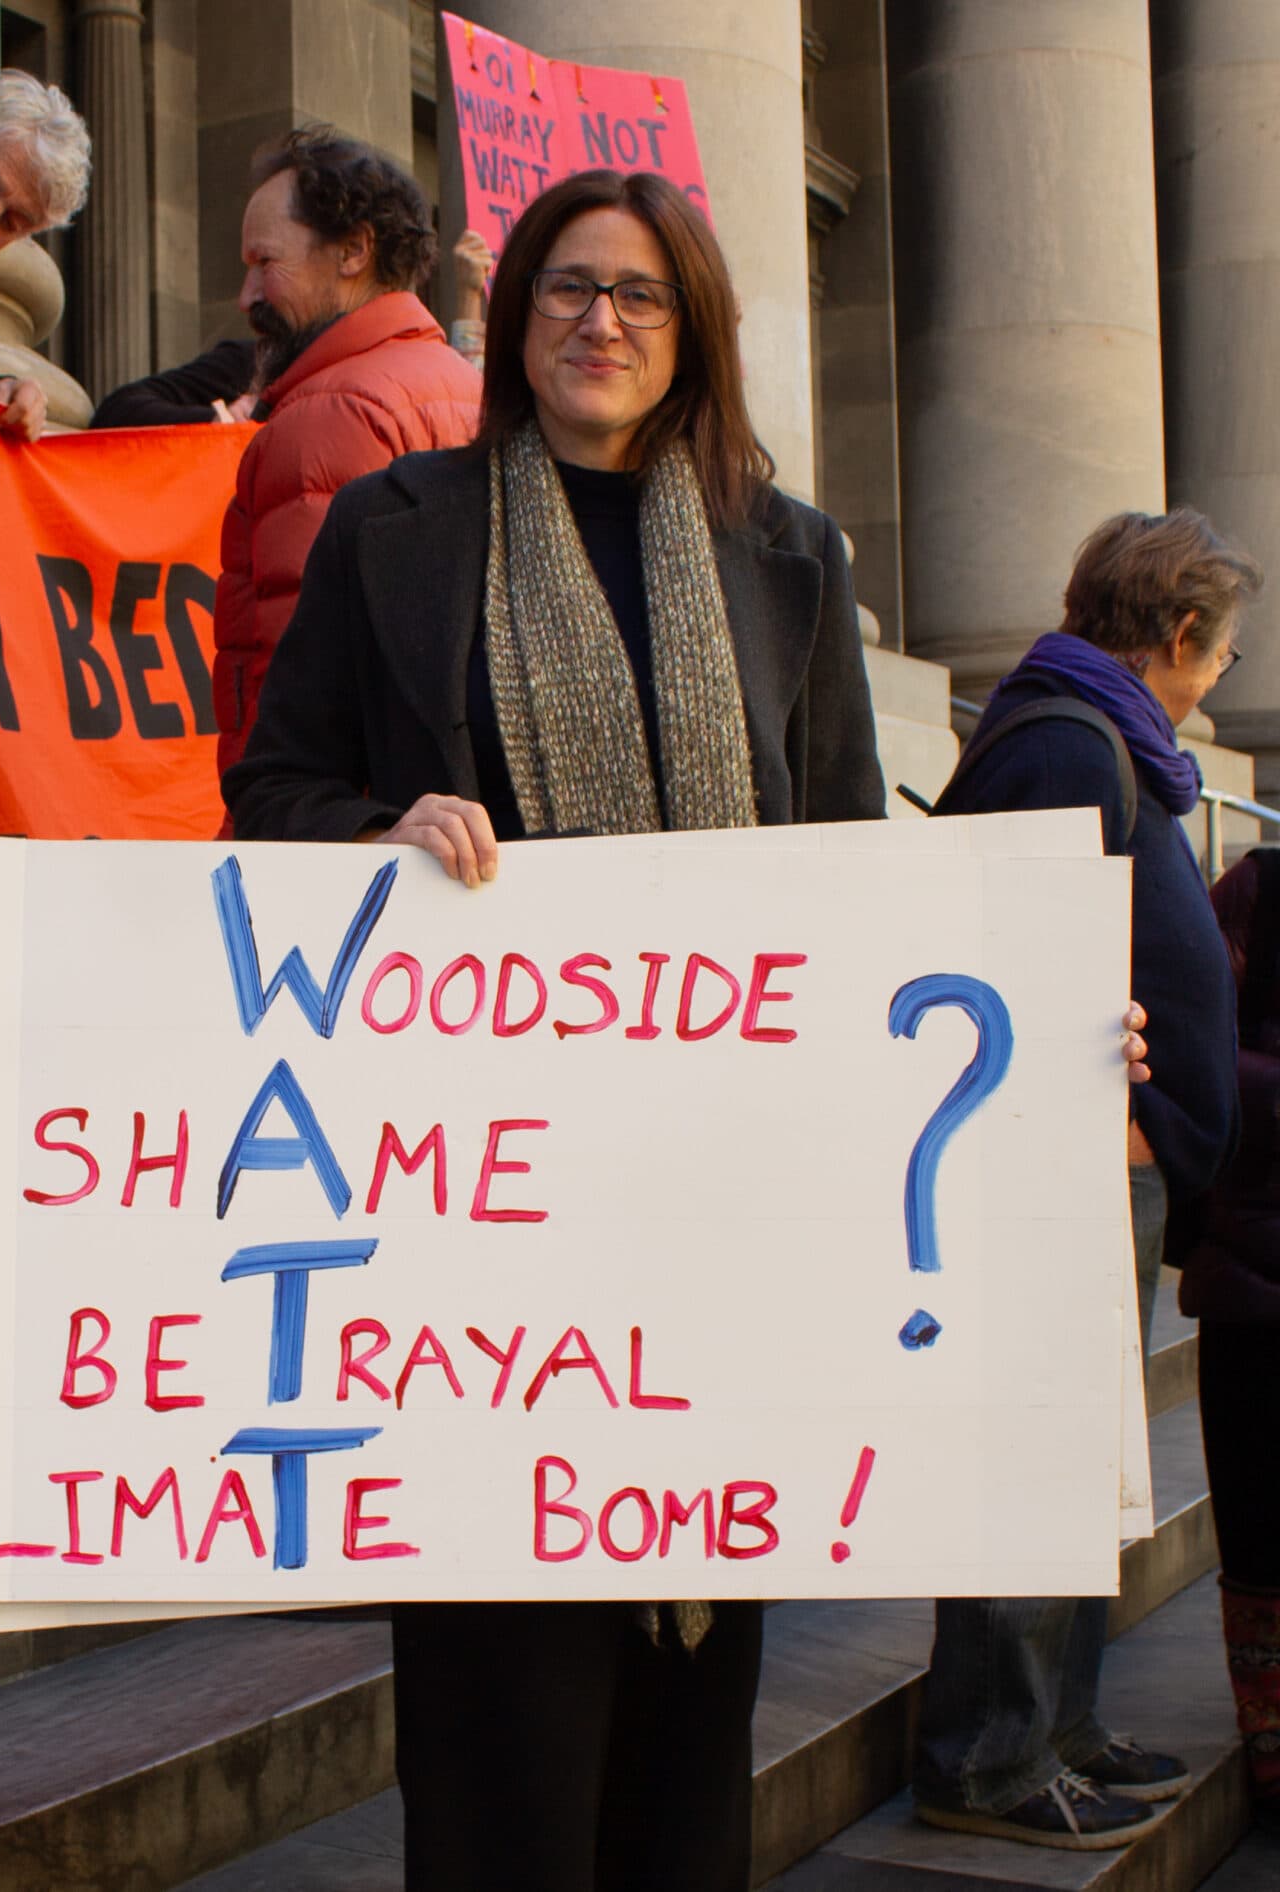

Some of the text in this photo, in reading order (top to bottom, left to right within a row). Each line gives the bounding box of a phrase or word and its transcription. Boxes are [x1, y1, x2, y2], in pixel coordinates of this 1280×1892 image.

[455, 84, 555, 163] MURRAY
[470, 138, 550, 204] WATT
[580, 112, 667, 168] NOT
[210, 853, 808, 1044] WOODSIDE
[22, 1058, 552, 1223] SHAME
[888, 973, 1015, 1352] ?
[58, 1238, 692, 1413] BETRAYAL
